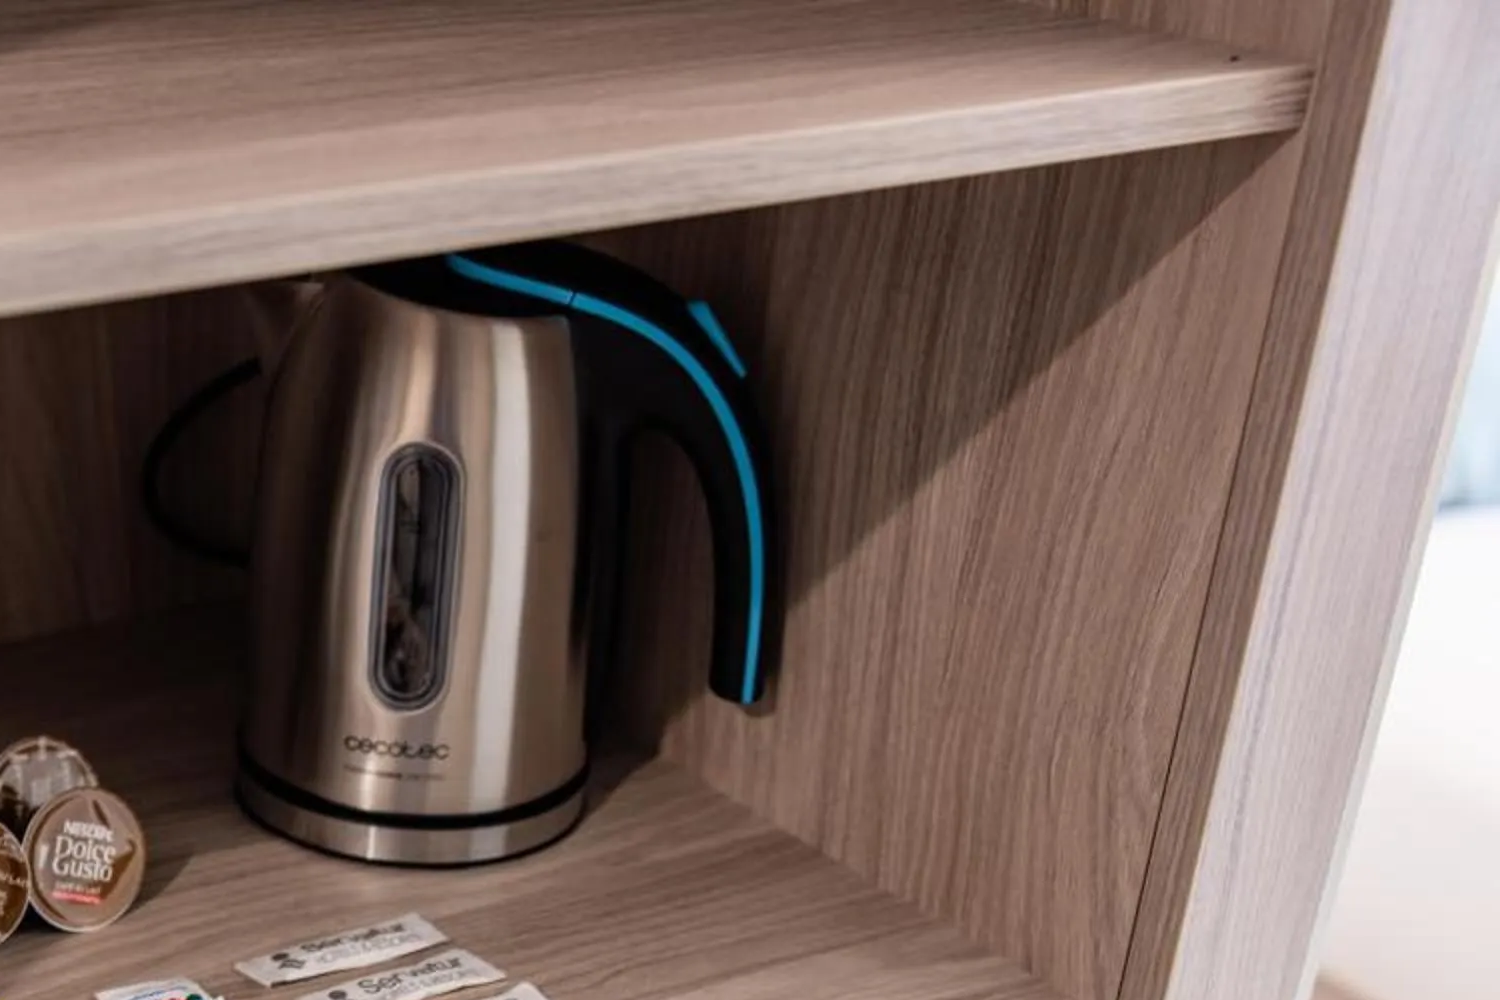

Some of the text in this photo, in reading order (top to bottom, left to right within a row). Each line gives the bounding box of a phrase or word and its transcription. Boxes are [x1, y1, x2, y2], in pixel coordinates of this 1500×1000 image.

[344, 735, 450, 760] cecotec
[56, 835, 117, 863] Dolce
[52, 854, 113, 882] Gusto
[358, 957, 462, 994] Servatur
